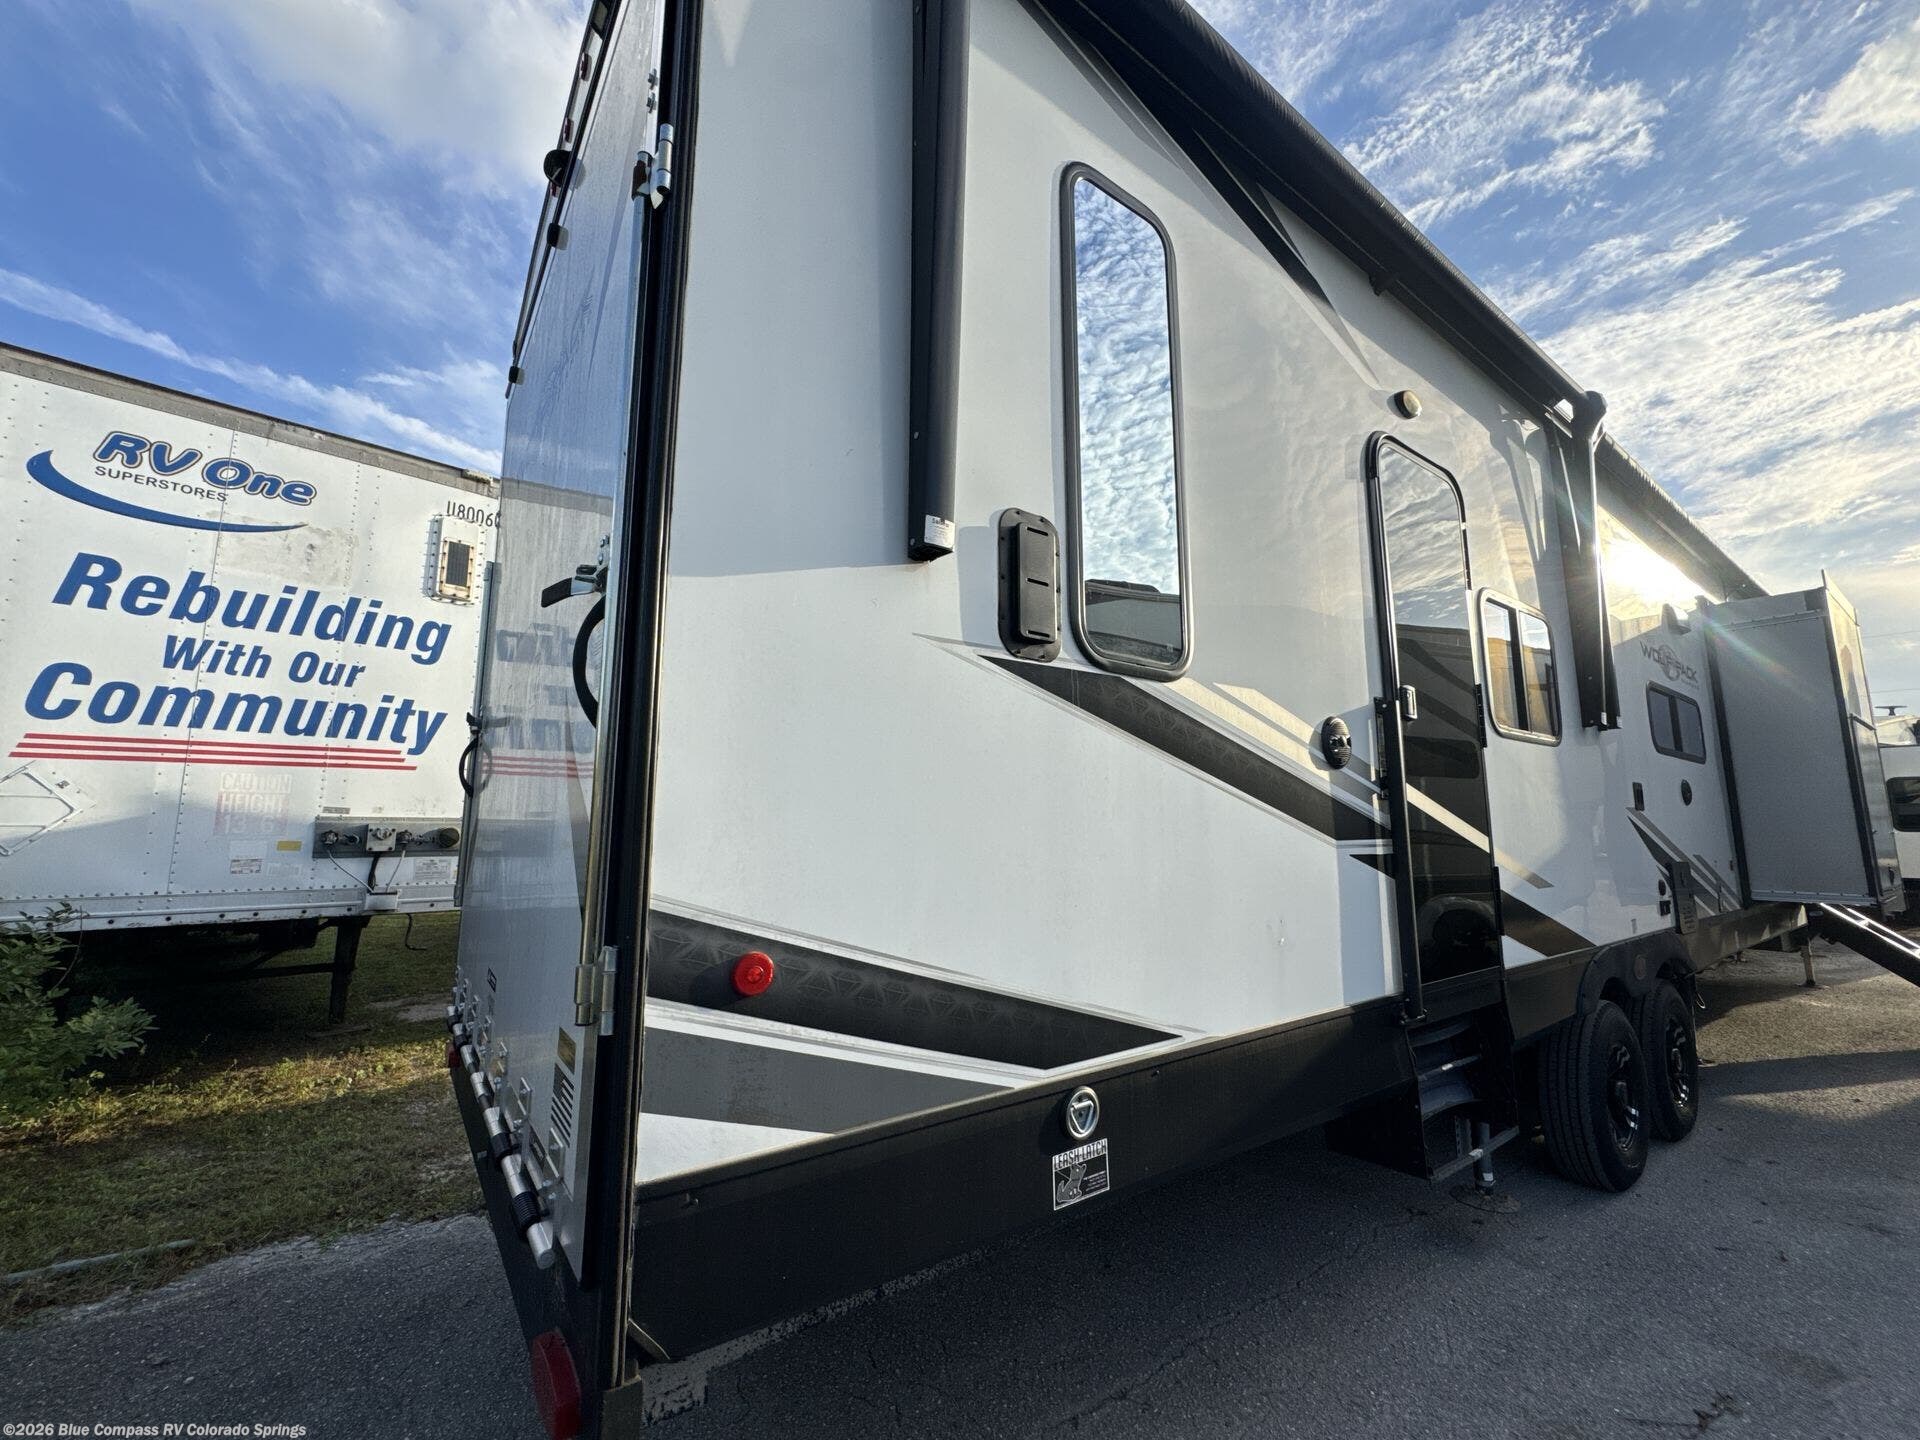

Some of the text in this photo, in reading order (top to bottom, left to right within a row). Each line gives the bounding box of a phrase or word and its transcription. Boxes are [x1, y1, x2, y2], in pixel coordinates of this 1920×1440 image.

[93, 430, 317, 506] RV One
[95, 466, 228, 502] SUPERSTORES
[52, 552, 452, 665] Rebuilding
[162, 635, 366, 687] With Our
[24, 662, 448, 755] Community
[220, 792, 285, 815] HEIGHT
[221, 773, 291, 793] CAUTION
